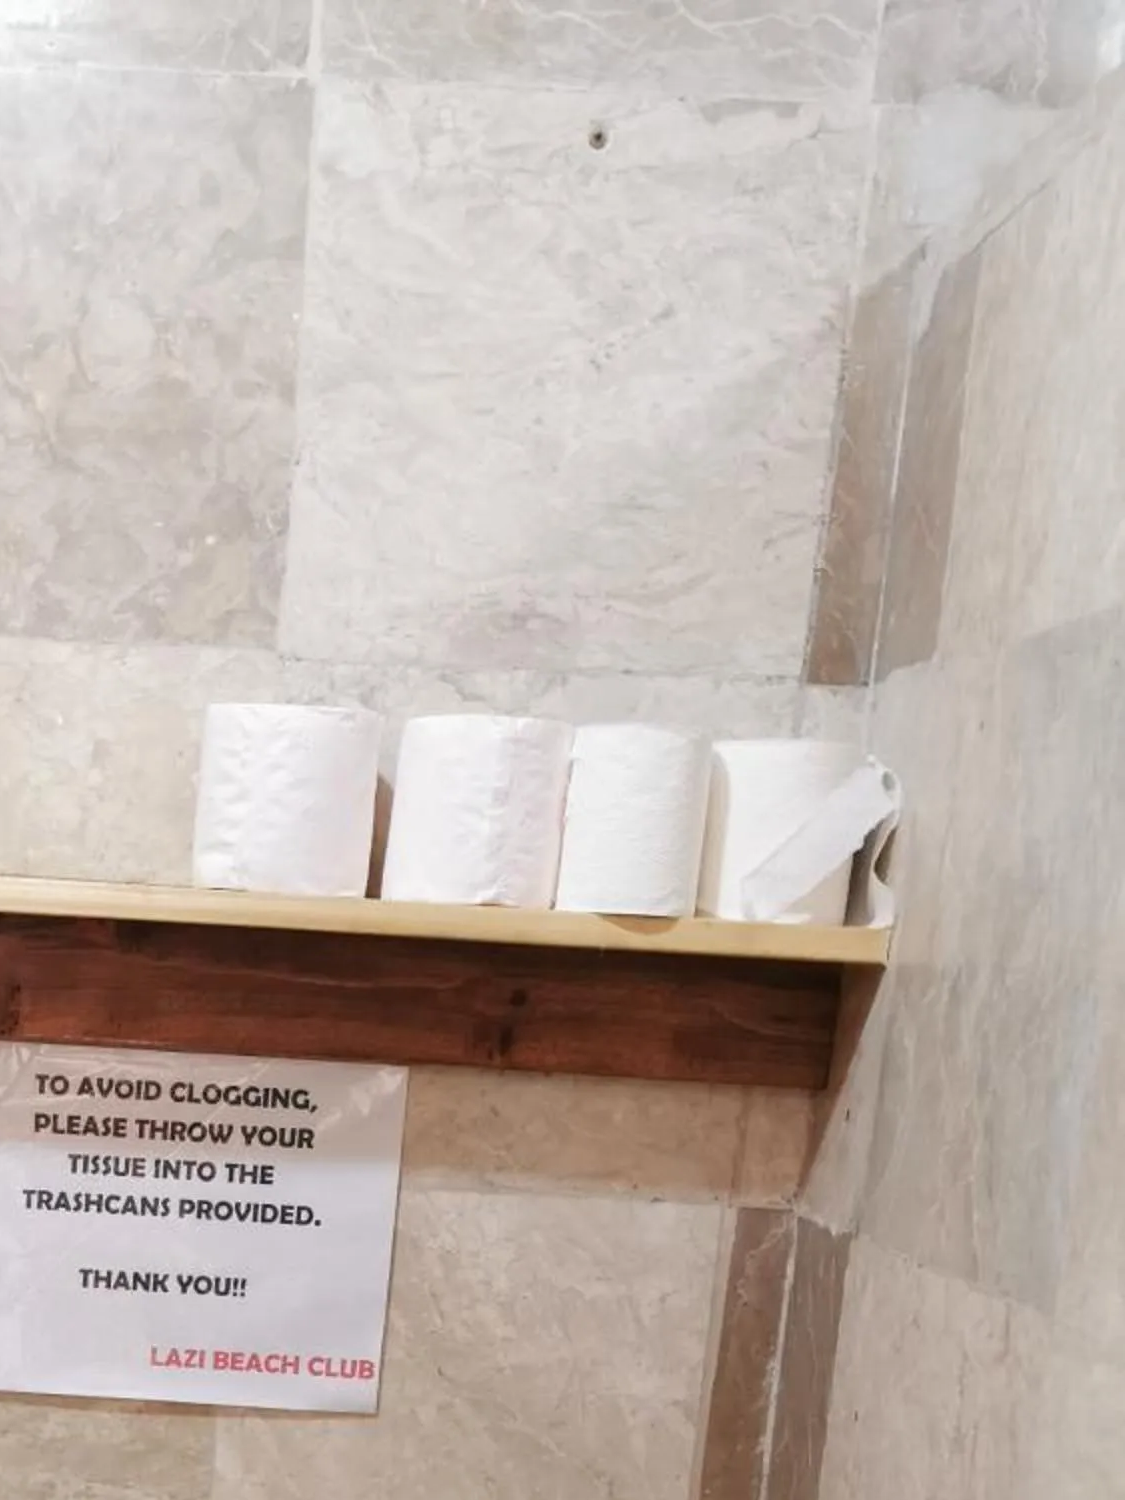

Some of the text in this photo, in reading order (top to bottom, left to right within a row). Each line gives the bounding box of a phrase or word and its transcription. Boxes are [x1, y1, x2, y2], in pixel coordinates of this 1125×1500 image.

[35, 1074, 317, 1113] TO AVOID CLOGGING,
[35, 1113, 314, 1149] PLEASE THROW YOUR
[68, 1154, 274, 1184] TISSUE INTO THE
[23, 1190, 321, 1226] TRASHCANS PROVIDED.
[79, 1269, 246, 1297] THANK YOU!!
[151, 1347, 375, 1380] LAZI BEACH CLUB
